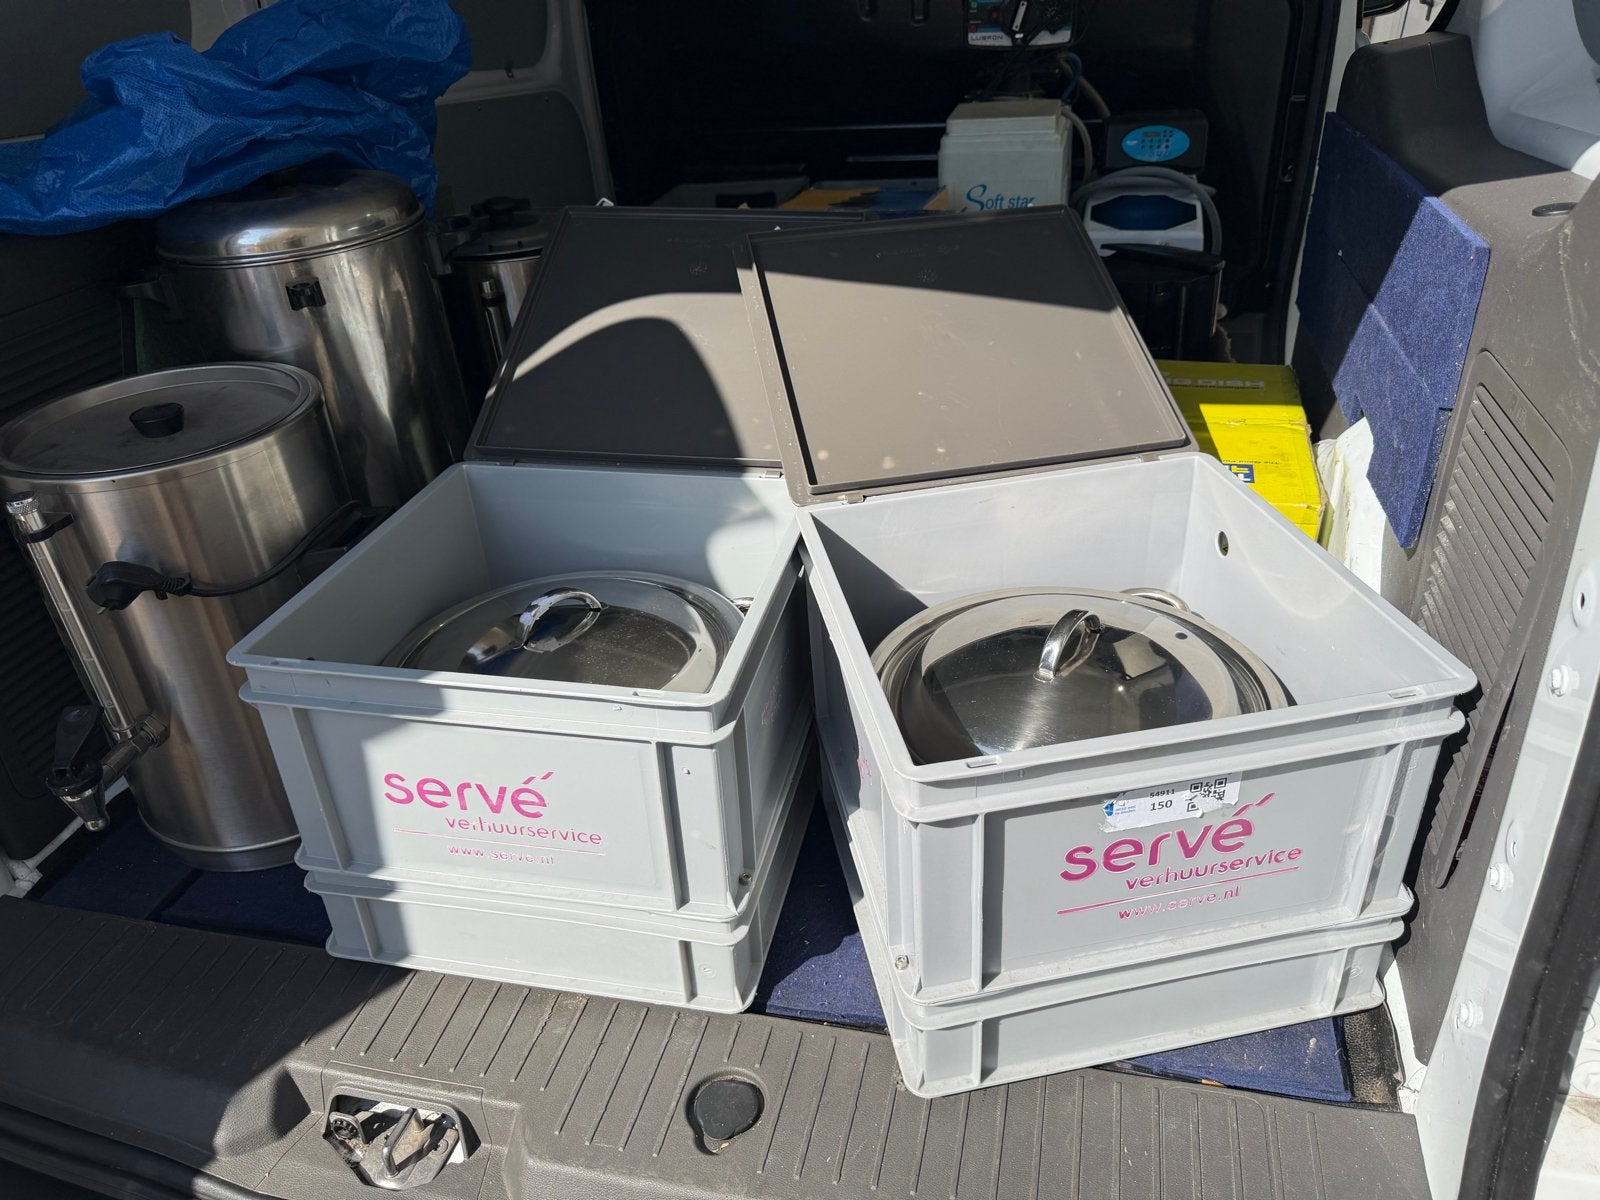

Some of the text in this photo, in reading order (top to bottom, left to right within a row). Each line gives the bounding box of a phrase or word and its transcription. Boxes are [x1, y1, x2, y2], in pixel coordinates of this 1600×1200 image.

[963, 184, 1035, 212] Soft star
[383, 771, 554, 819] servé
[1149, 788, 1175, 798] 54911
[1150, 799, 1173, 812] 150
[1060, 792, 1275, 882] servé
[1125, 847, 1302, 890] verhuurservice
[1118, 886, 1240, 919] www.serve.nl
